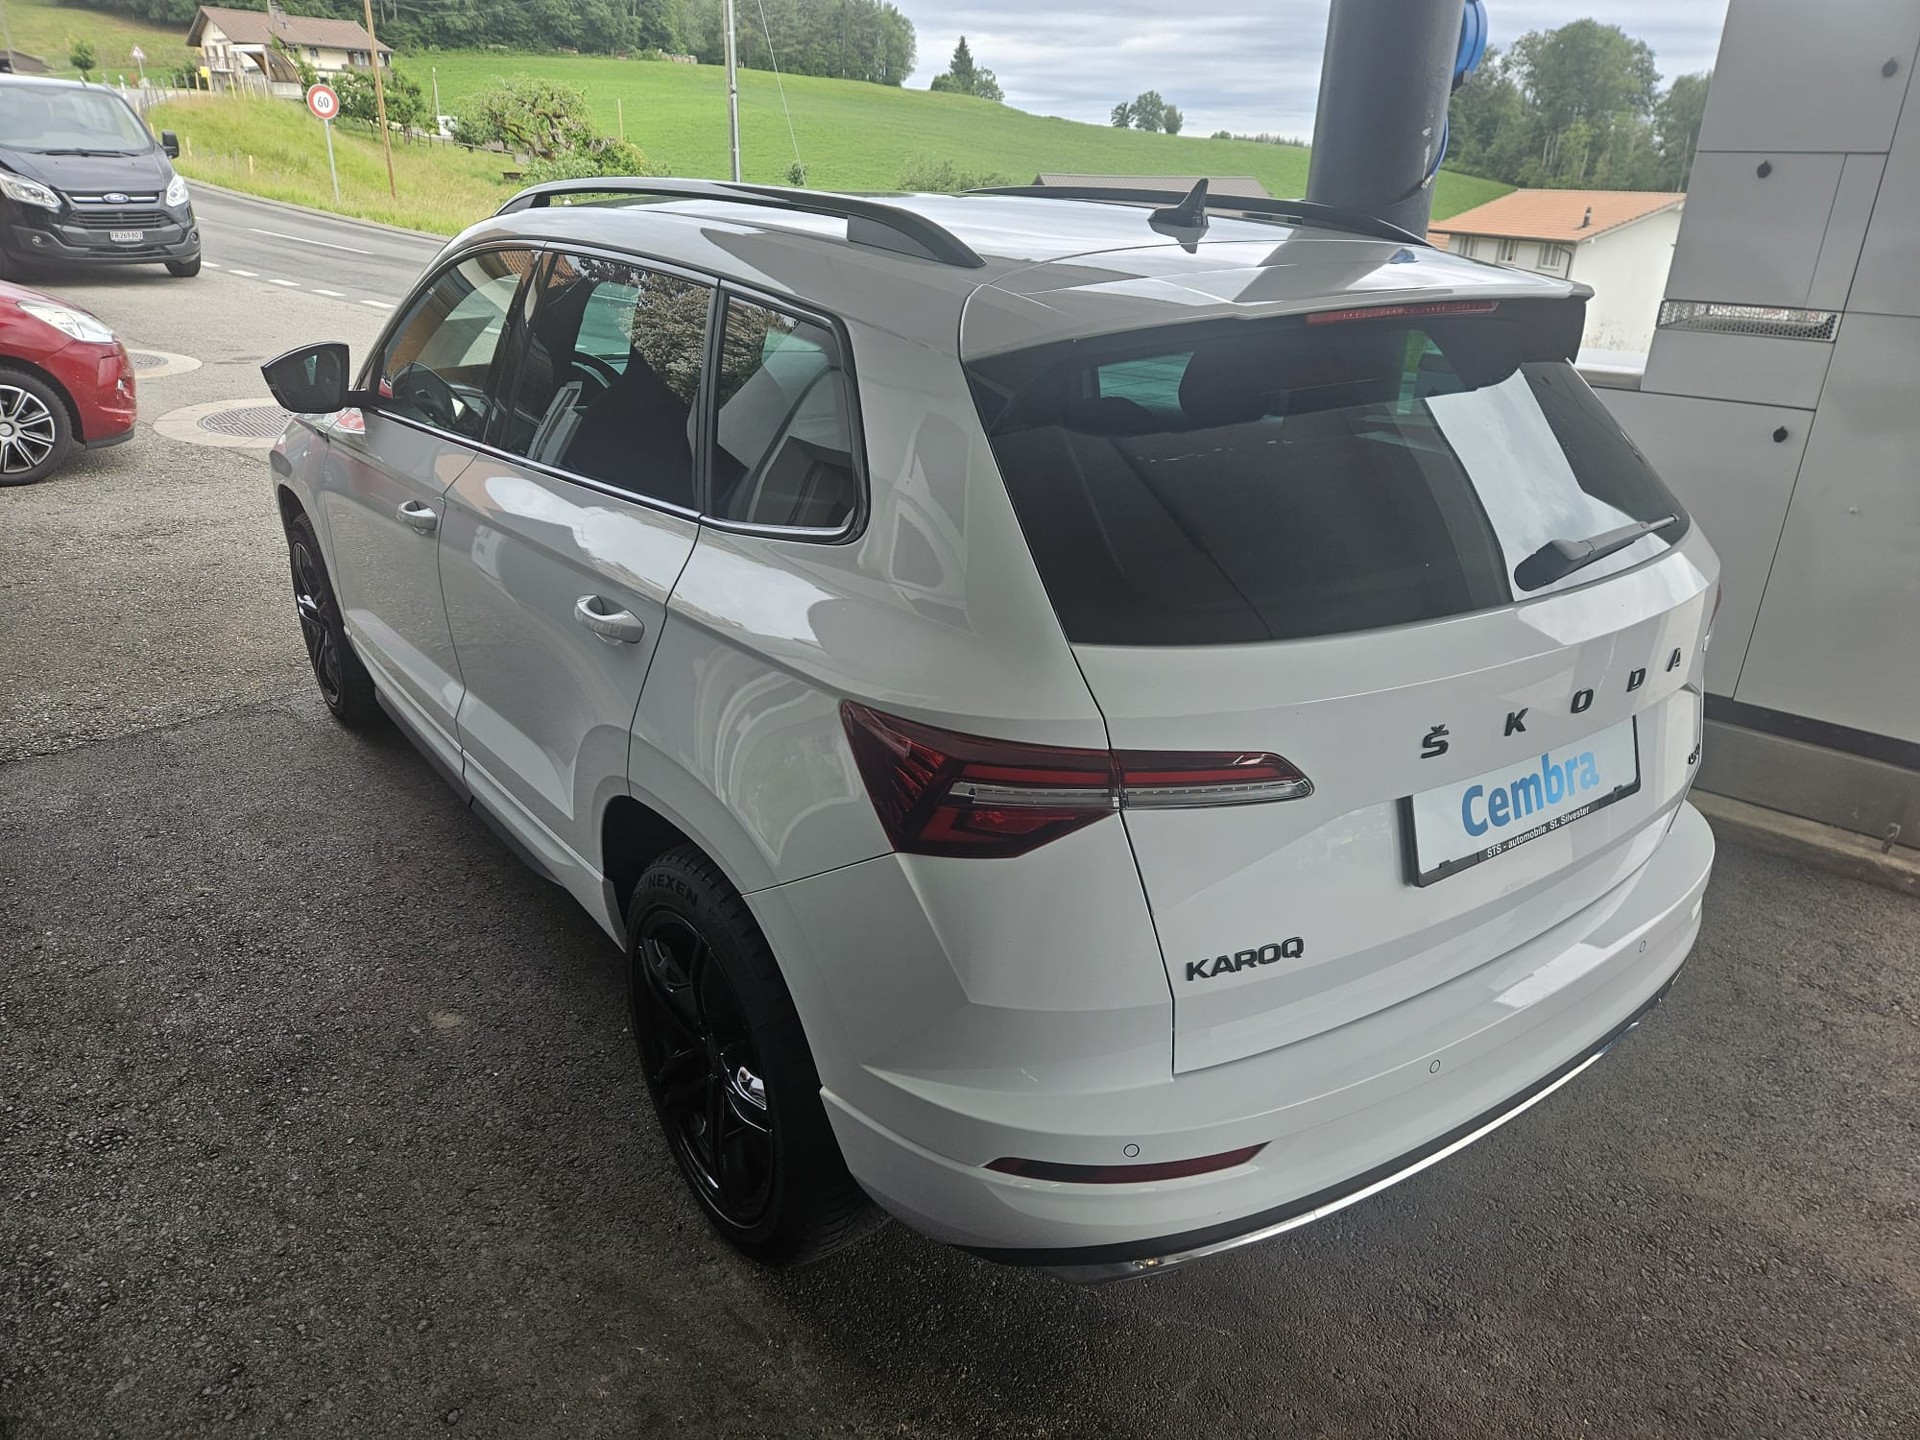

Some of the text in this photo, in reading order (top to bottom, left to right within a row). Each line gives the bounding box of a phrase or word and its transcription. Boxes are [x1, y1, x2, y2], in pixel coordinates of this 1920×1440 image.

[317, 96, 329, 108] 60
[1421, 647, 1682, 759] ŠKODA
[1461, 752, 1600, 838] Cembra
[1487, 844, 1502, 858] STS
[1508, 825, 1547, 849] automobile
[1549, 819, 1560, 830] St.
[1560, 806, 1591, 825] Silvester
[648, 873, 698, 907] NEXEN
[1186, 936, 1304, 981] KAROQ
